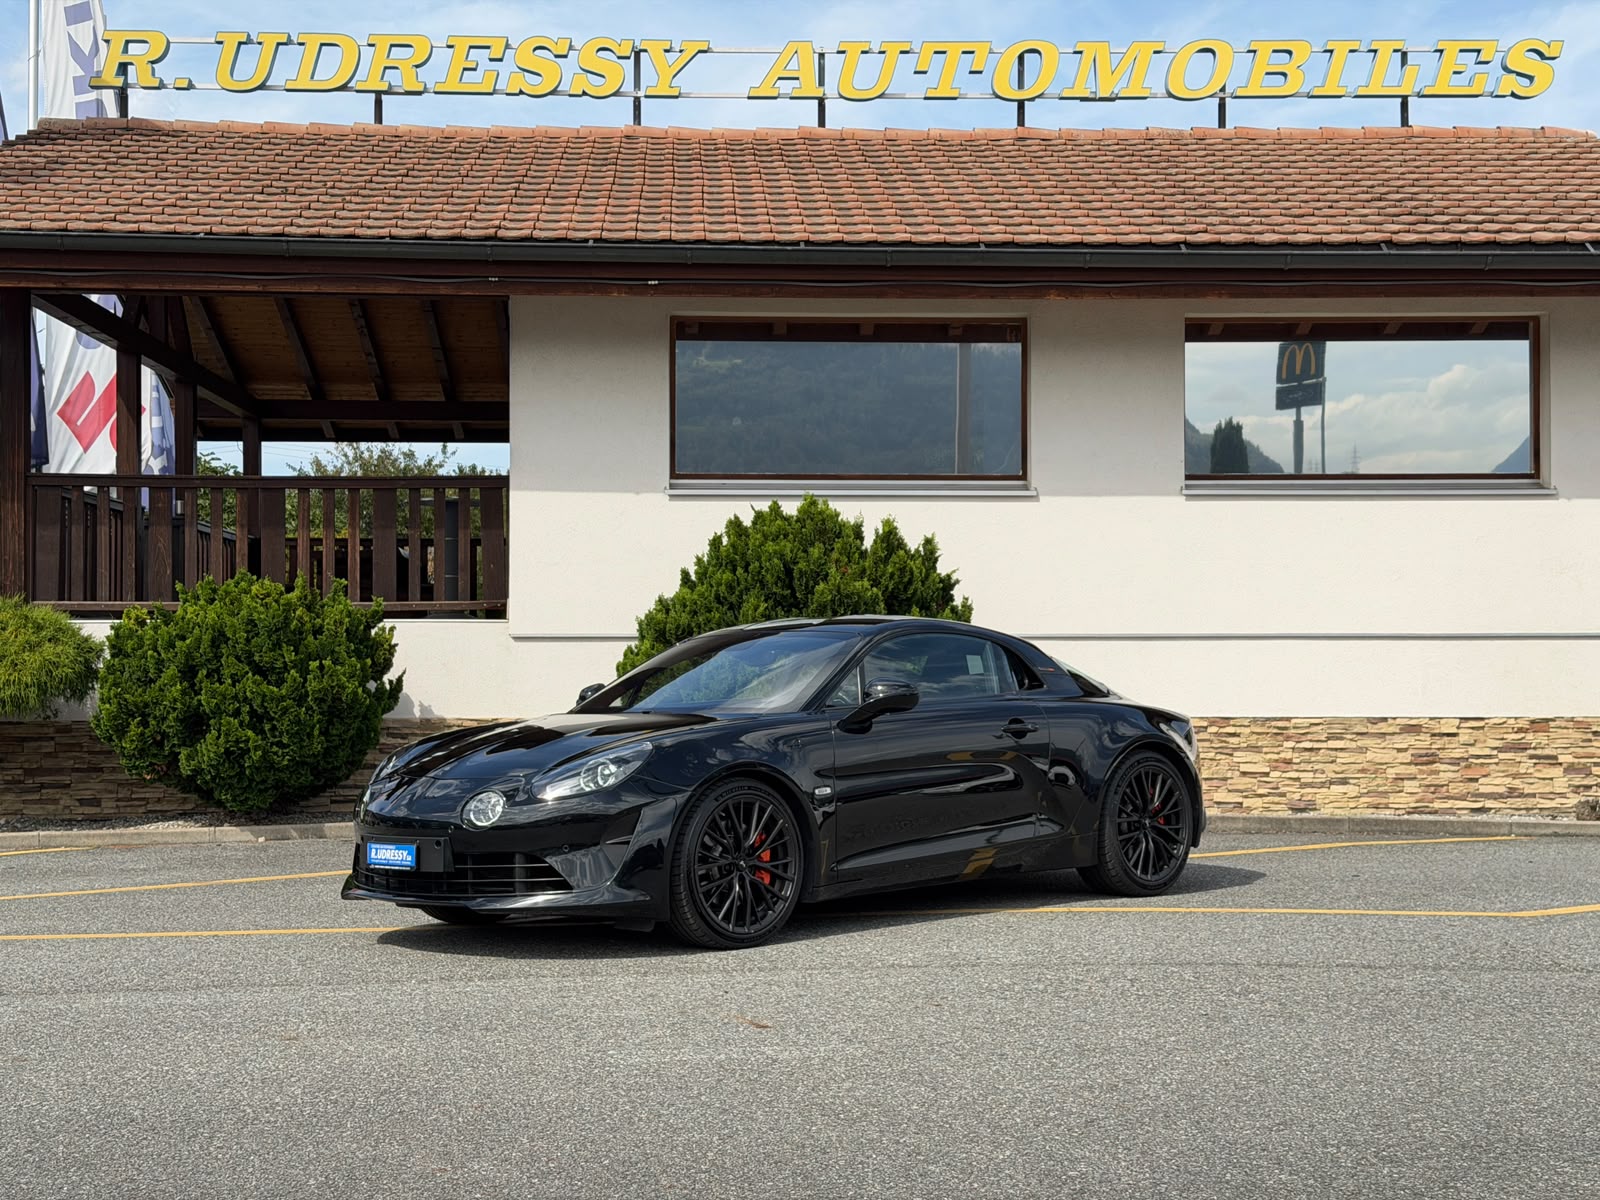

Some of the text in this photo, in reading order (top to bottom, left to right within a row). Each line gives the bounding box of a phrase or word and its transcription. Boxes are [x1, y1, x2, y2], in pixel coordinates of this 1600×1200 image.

[89, 30, 192, 90] R.
[214, 31, 709, 97] UDRESSY
[748, 39, 1564, 100] AUTOMOBILES
